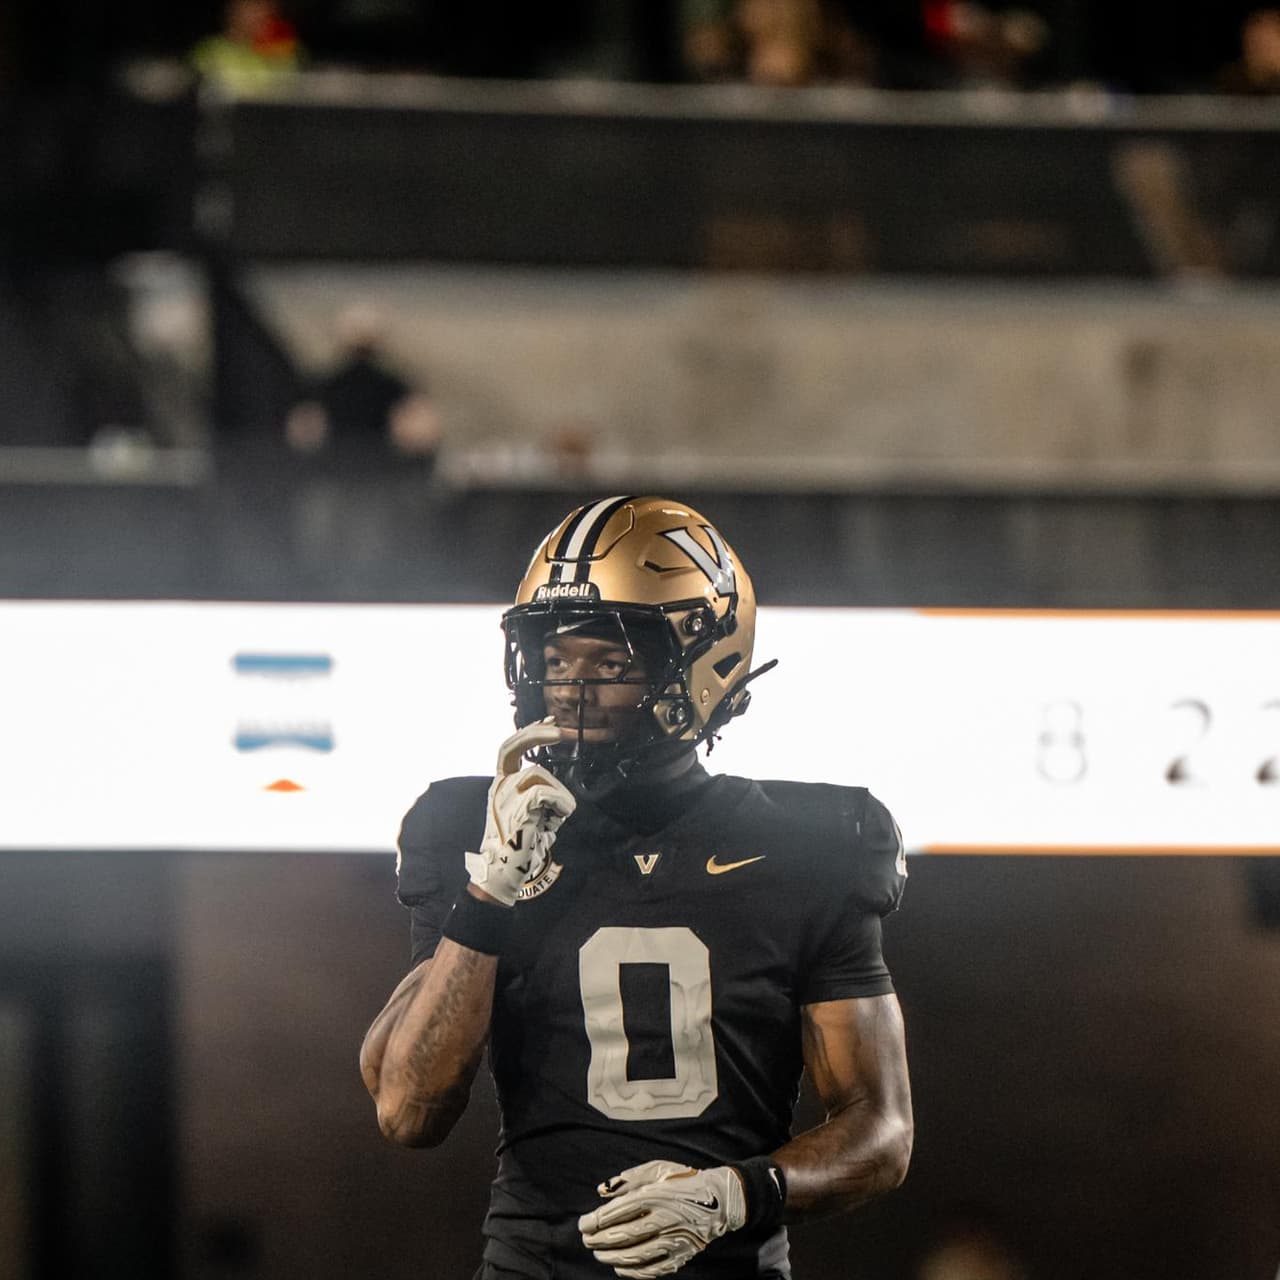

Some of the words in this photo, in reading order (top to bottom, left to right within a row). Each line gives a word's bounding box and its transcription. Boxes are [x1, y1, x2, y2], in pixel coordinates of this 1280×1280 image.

[657, 525, 737, 598] V
[537, 583, 591, 599] Riddell
[633, 853, 659, 875] V
[517, 875, 553, 899] DUATE
[579, 926, 718, 1121] 0
